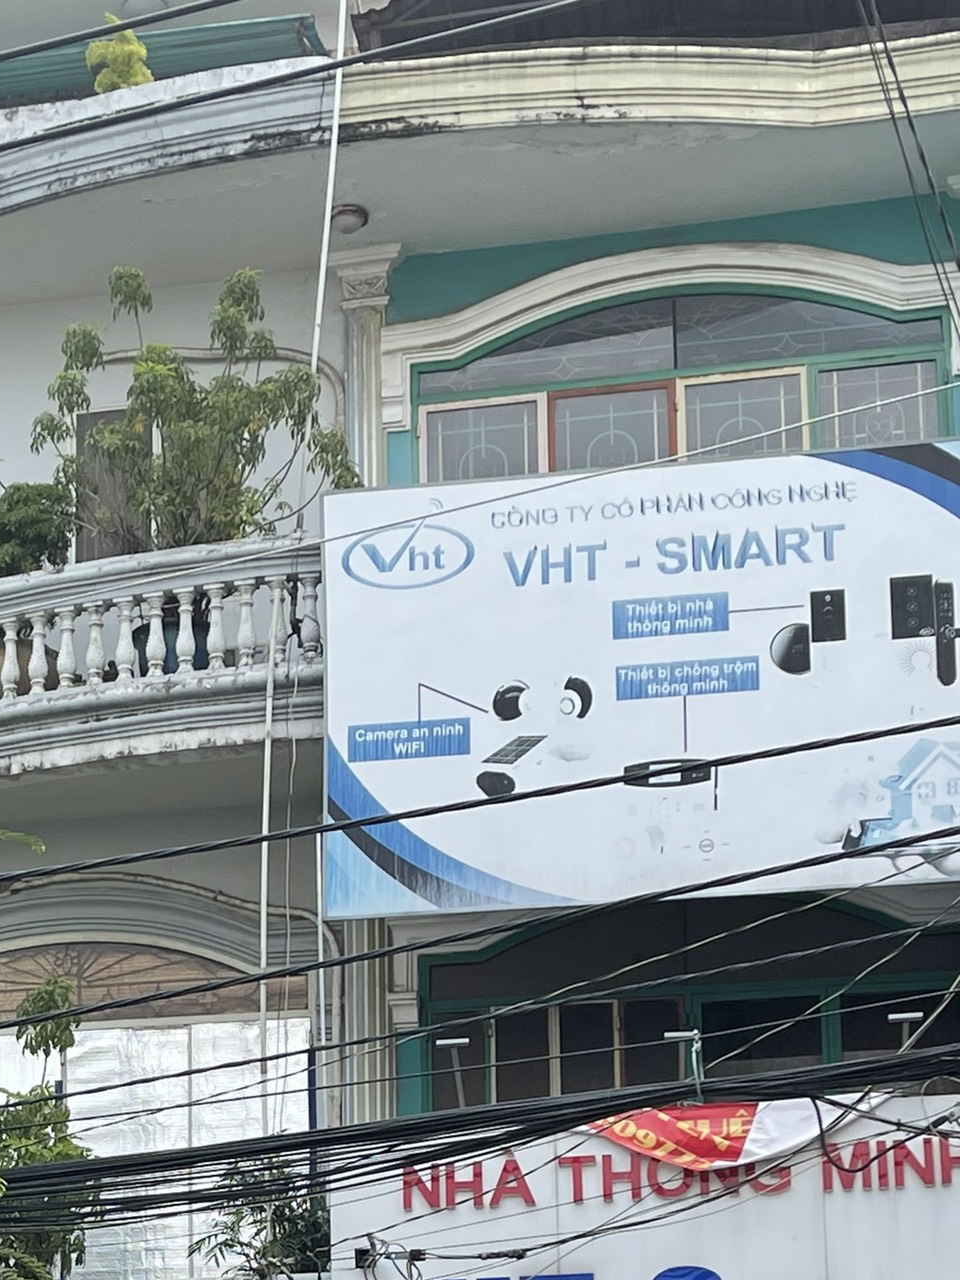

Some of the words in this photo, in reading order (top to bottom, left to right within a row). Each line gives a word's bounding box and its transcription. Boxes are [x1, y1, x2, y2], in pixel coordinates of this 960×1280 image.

[565, 505, 592, 523] TY
[360, 517, 446, 573] Vht
[503, 539, 607, 587] VHT
[656, 522, 846, 575] SMART
[627, 618, 670, 633] thông
[675, 615, 713, 629] minh
[647, 681, 688, 696] thông
[693, 679, 728, 692] minh
[355, 728, 408, 742] Camera
[412, 727, 429, 738] an
[433, 723, 464, 736] ninh
[393, 741, 425, 755] WIFI
